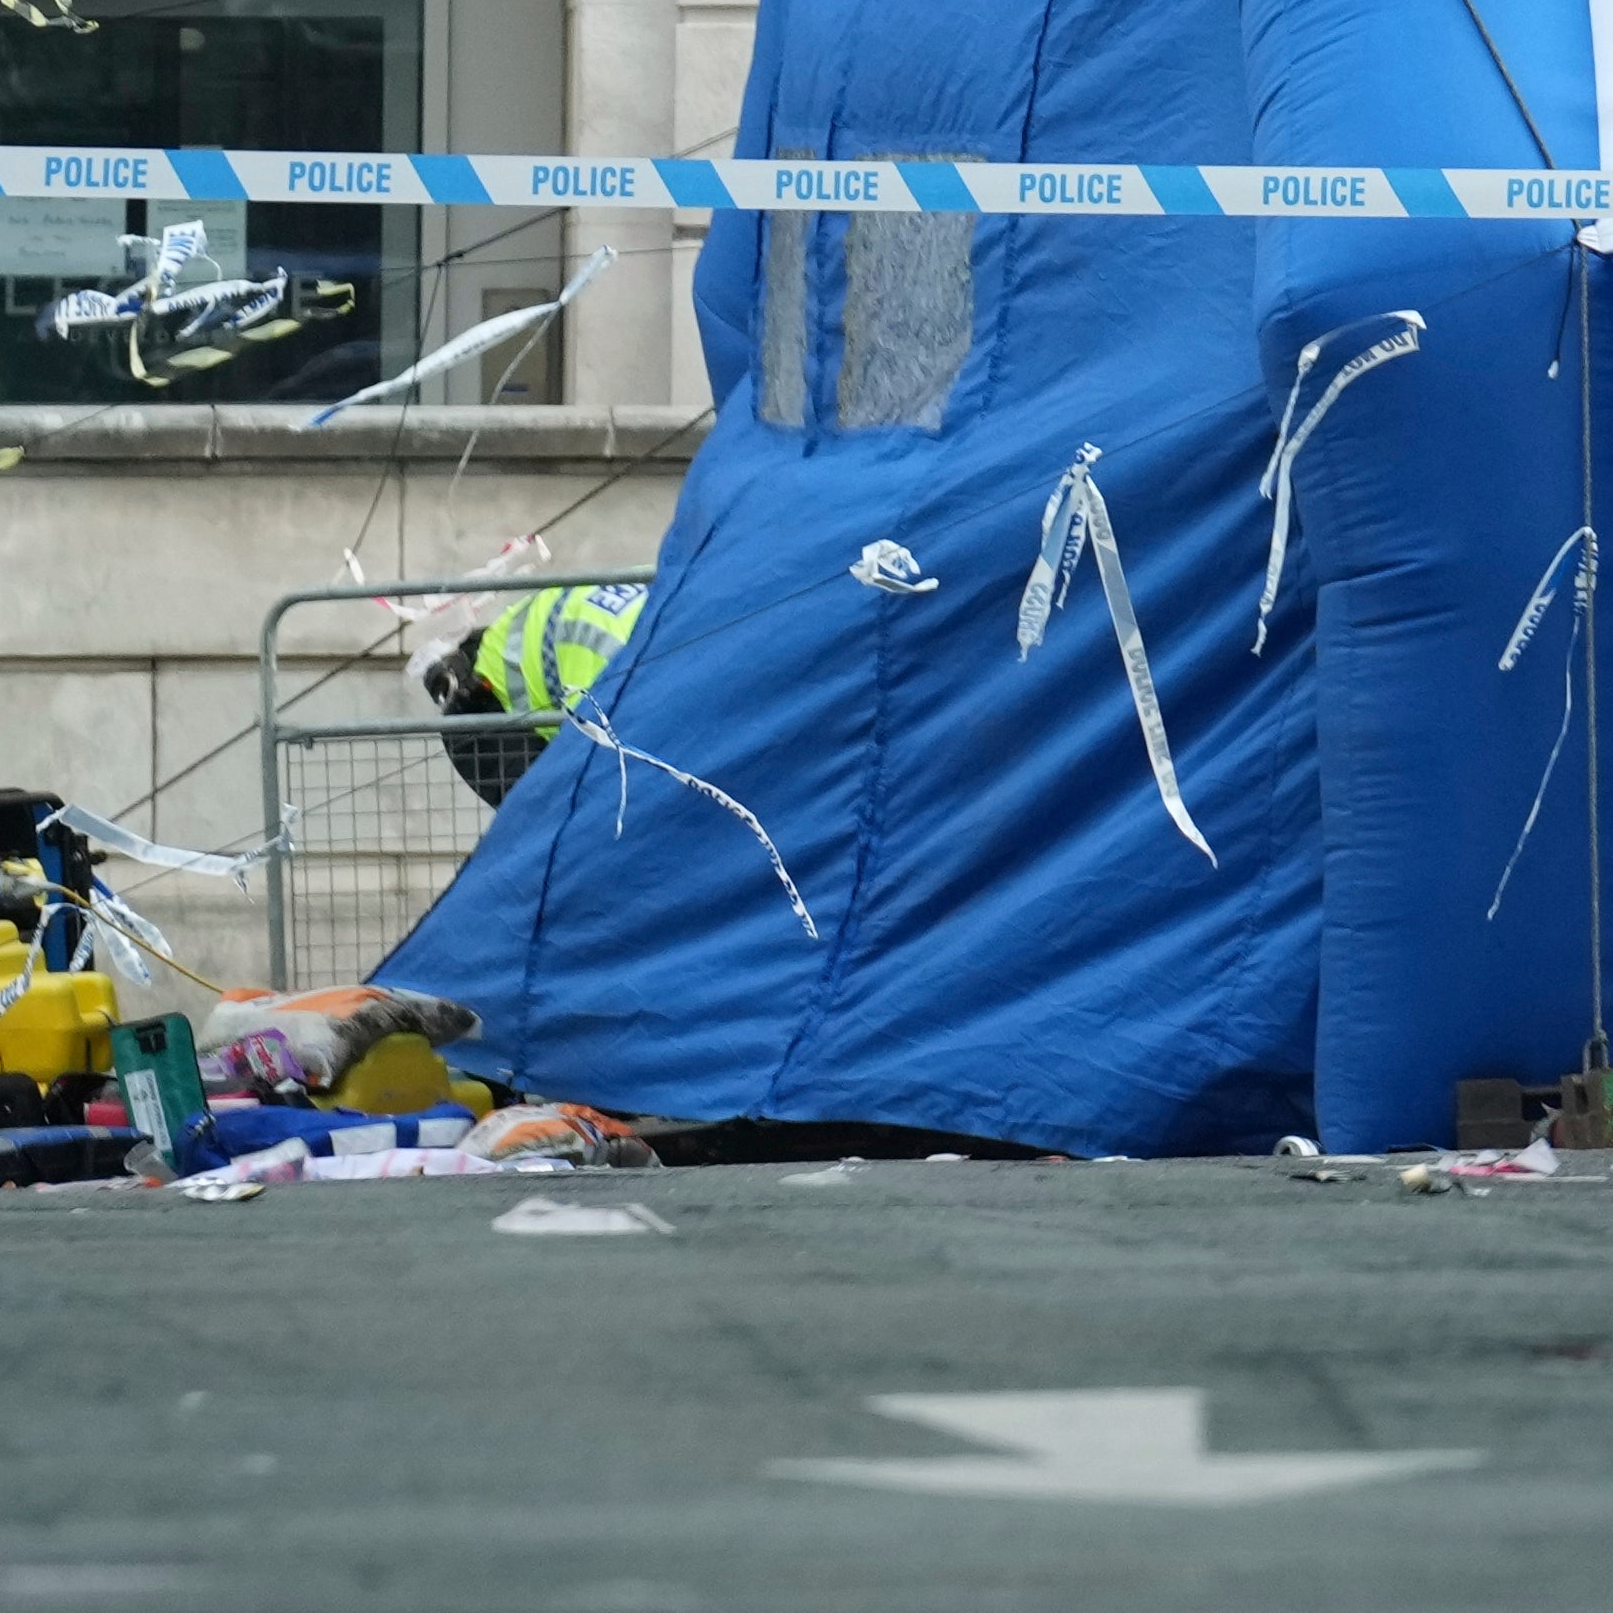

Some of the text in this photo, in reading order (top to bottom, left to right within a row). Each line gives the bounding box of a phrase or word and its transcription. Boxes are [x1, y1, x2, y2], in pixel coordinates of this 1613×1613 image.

[44, 156, 151, 191] POLICE
[288, 161, 394, 196] POLICE
[532, 165, 637, 200] POLICE
[775, 169, 881, 204] POLICE
[1018, 172, 1124, 207] POLICE
[1262, 175, 1368, 210] POLICE
[1506, 177, 1613, 212] POLICE
